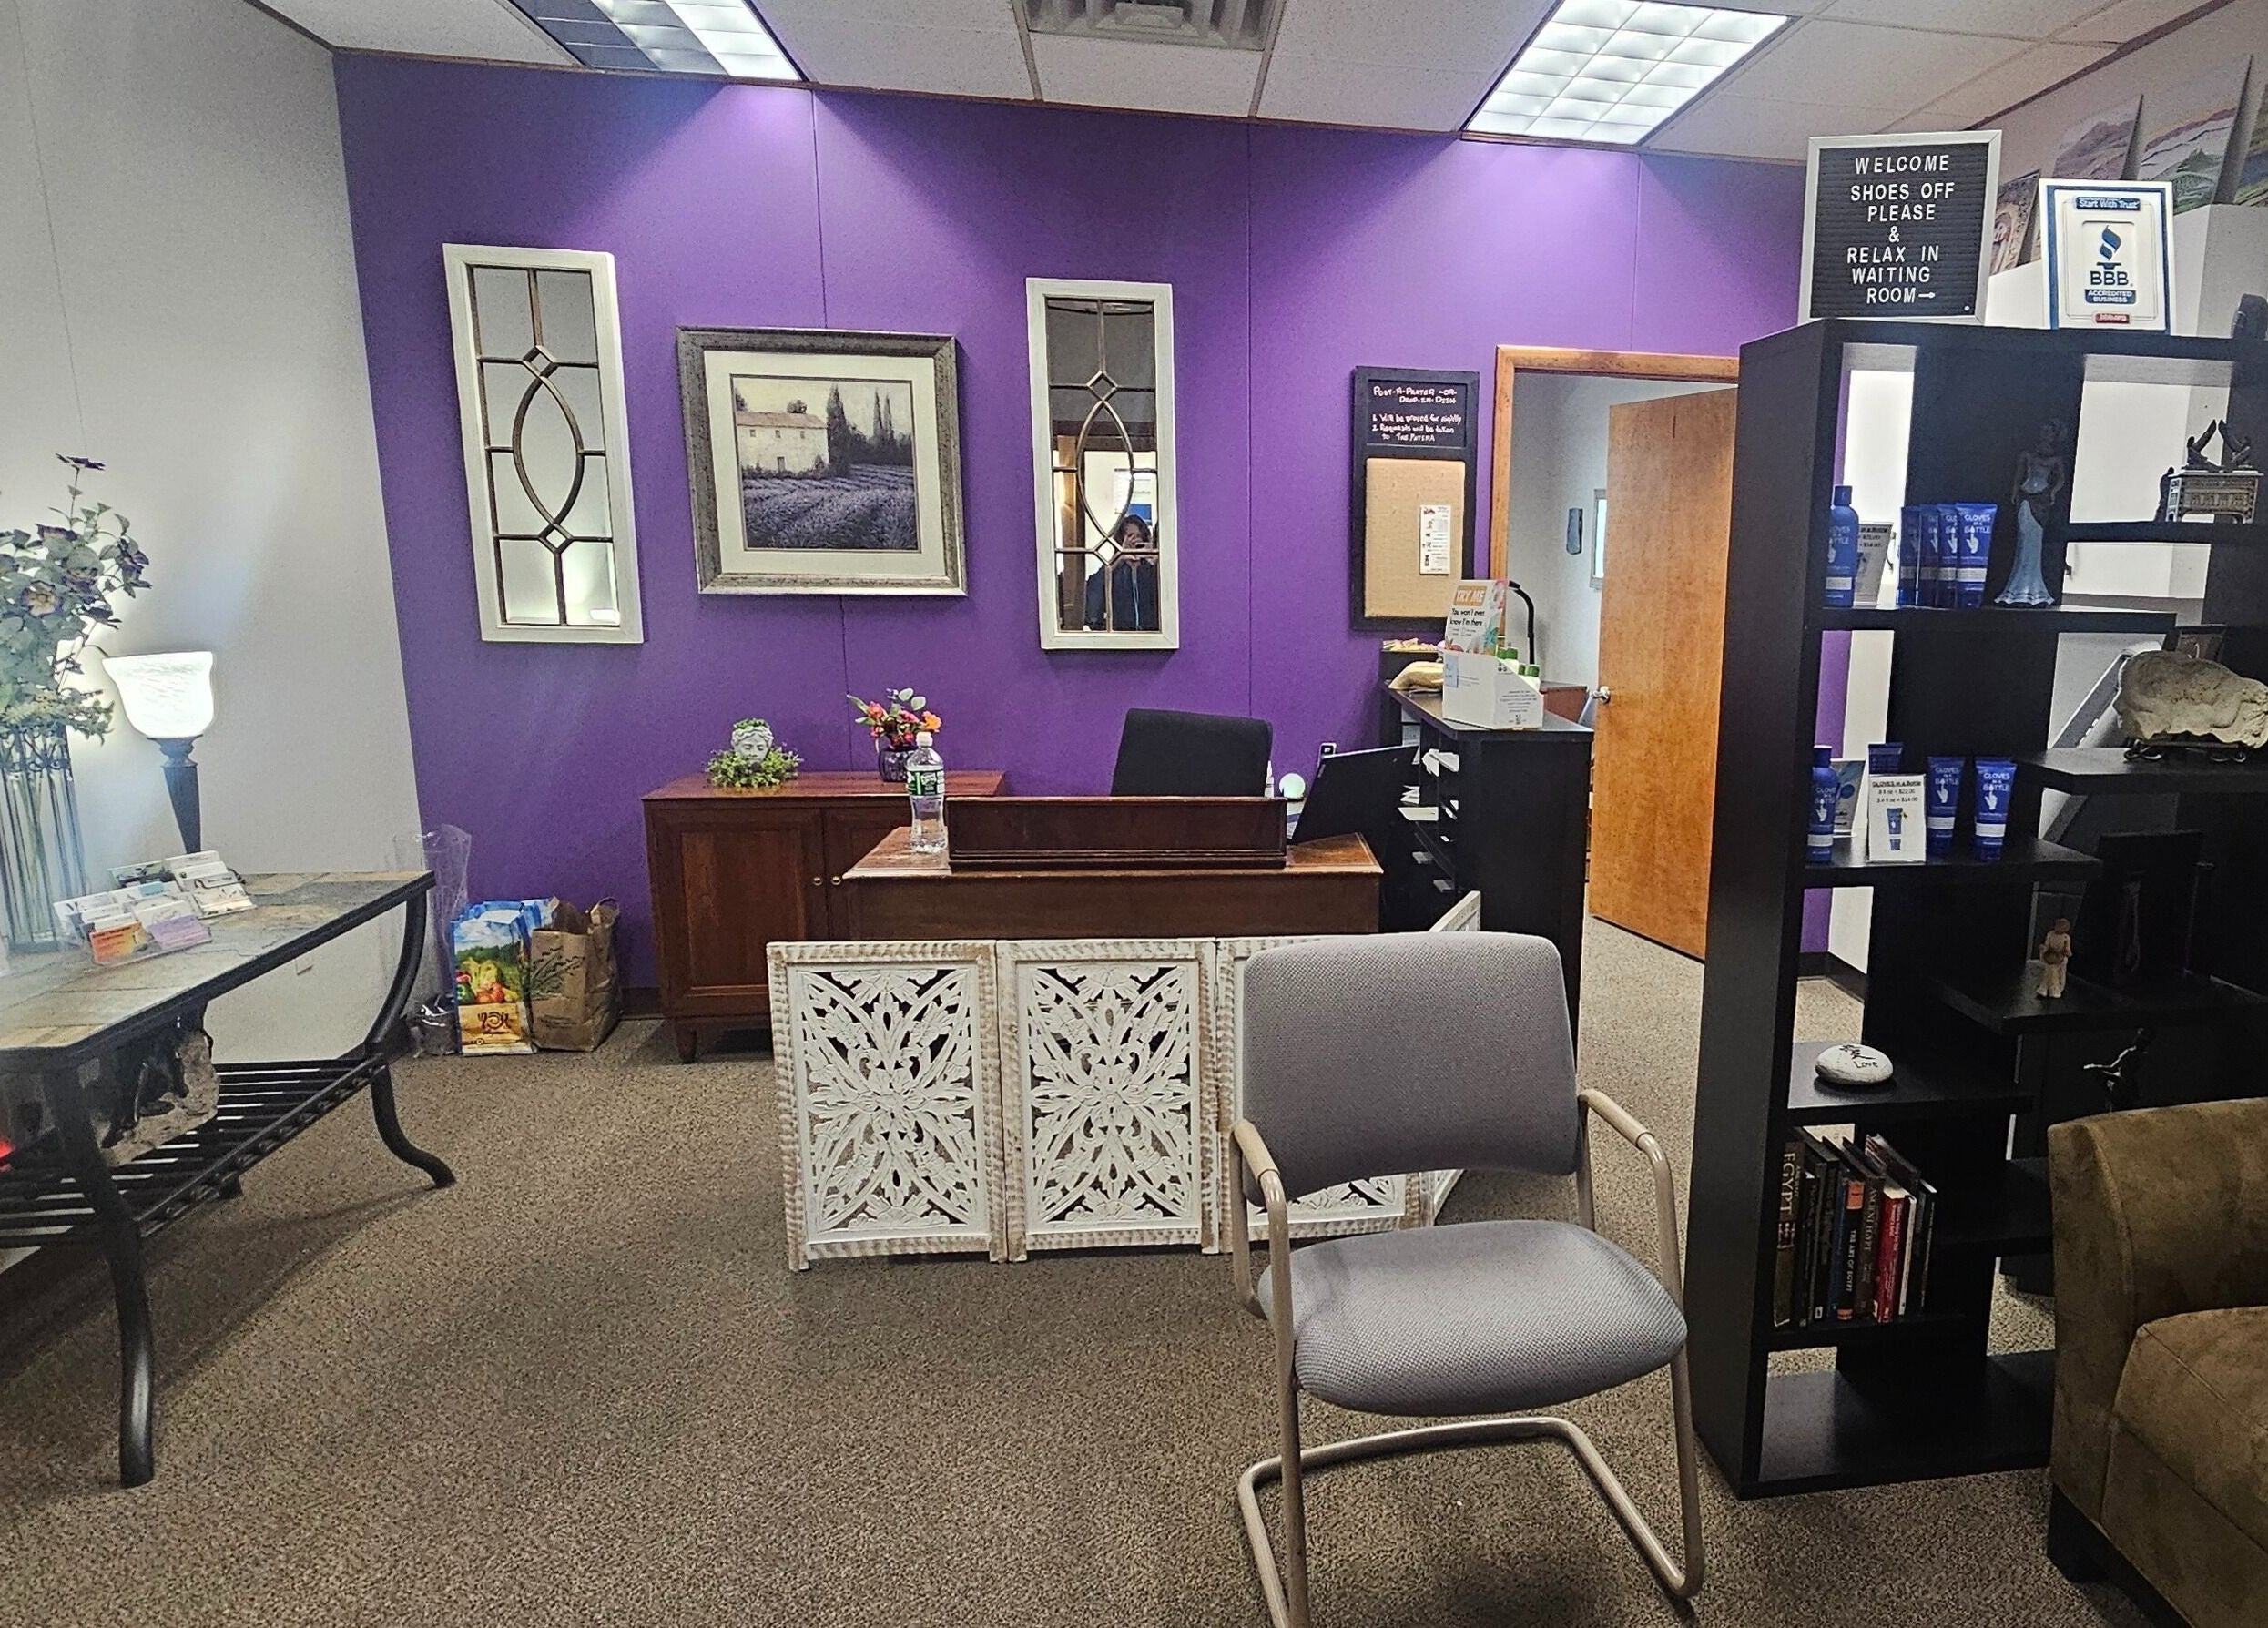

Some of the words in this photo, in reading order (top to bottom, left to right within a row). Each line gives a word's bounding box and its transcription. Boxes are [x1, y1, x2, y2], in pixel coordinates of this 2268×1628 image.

[1856, 155, 1949, 175] WELCOME
[1850, 183, 1910, 201] SHOES
[1920, 182, 1955, 198] OFF
[2079, 199, 2099, 208] Start
[2099, 198, 2118, 209] With
[2118, 200, 2138, 209] Trust
[1867, 204, 1936, 222] PLEASE
[1888, 226, 1900, 242] &
[1846, 246, 1906, 264] RELAX
[1921, 245, 1939, 262] IN
[1851, 266, 1930, 284] WAITING
[2090, 270, 2130, 286] BBB
[1866, 287, 1917, 304] ROOM
[1853, 1061, 1879, 1069] Love
[1779, 1153, 1795, 1215] EGYPT
[1849, 1229, 1857, 1243] THE
[1848, 1245, 1856, 1257] ART
[1846, 1260, 1855, 1269] OF
[1845, 1270, 1854, 1292] EGYPT
